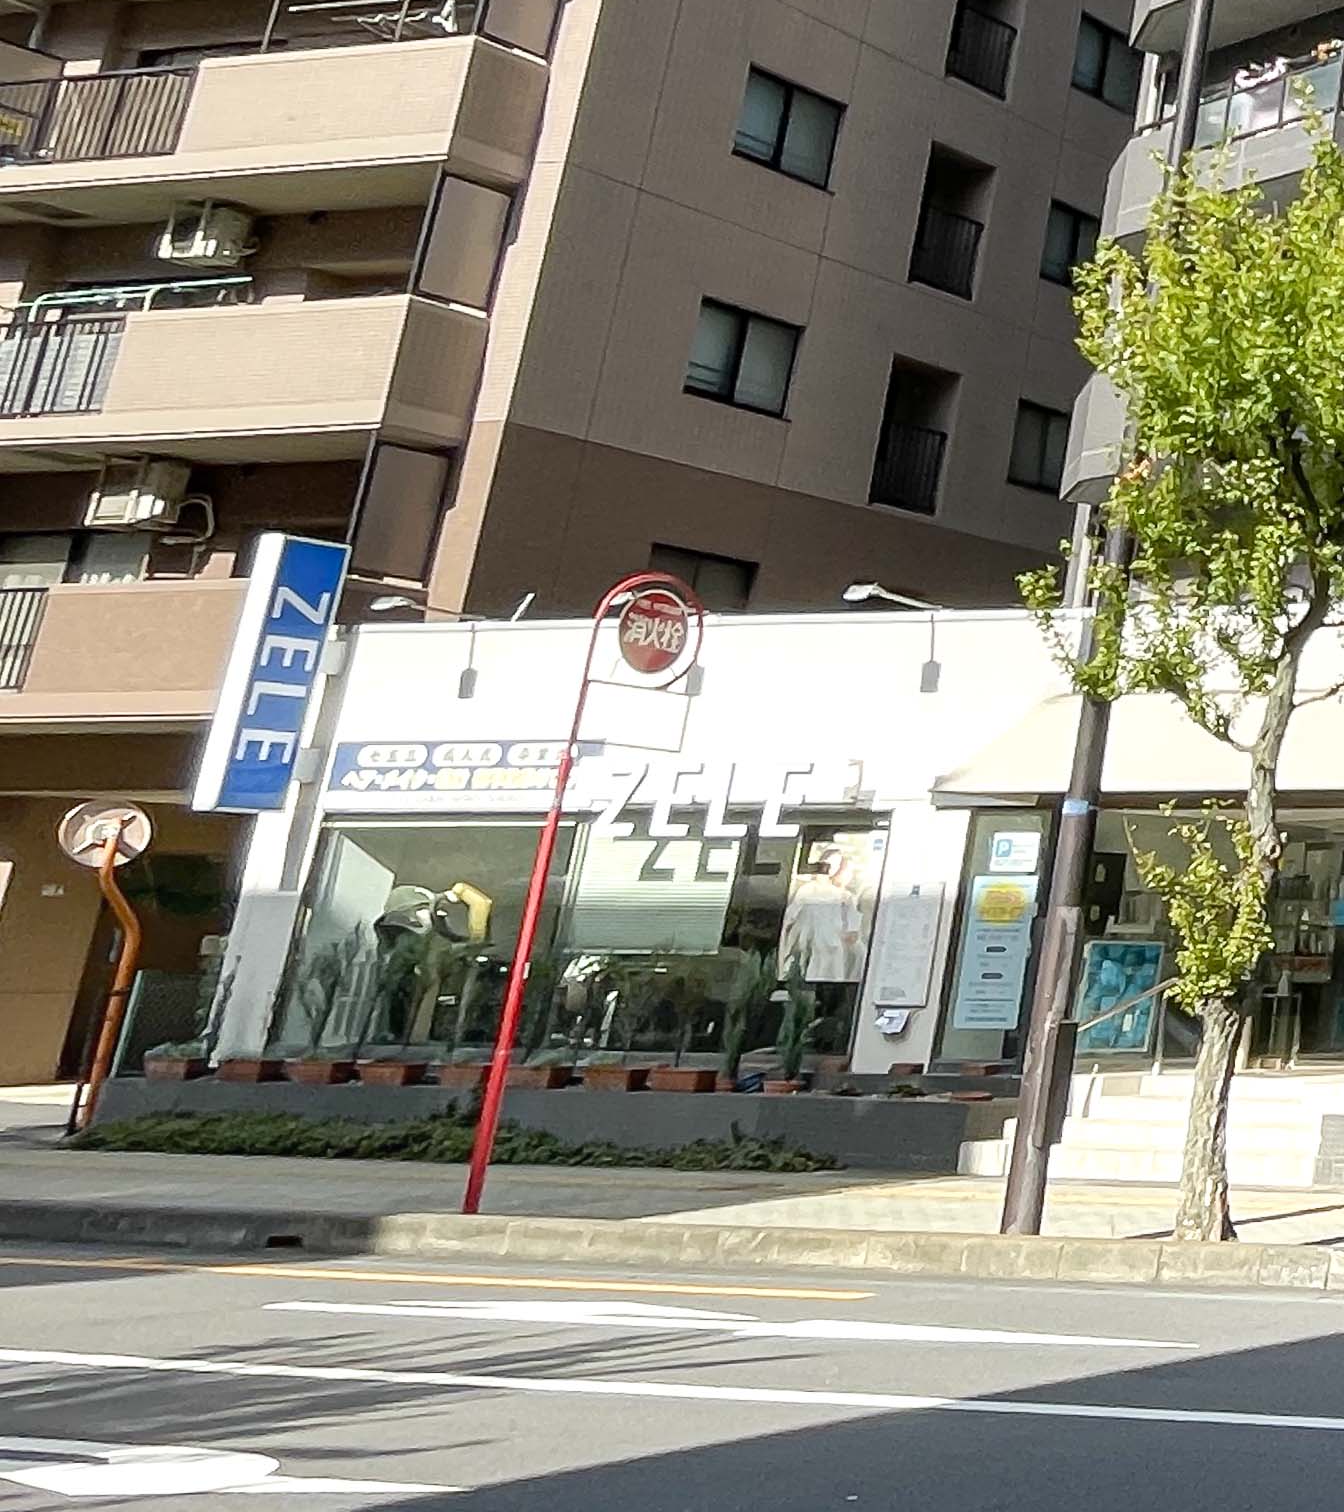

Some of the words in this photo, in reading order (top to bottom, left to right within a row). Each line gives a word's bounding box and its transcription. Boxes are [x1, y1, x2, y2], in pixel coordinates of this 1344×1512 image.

[623, 611, 685, 654] 消火栓
[236, 586, 331, 766] ZELE
[588, 759, 815, 837] ZELE
